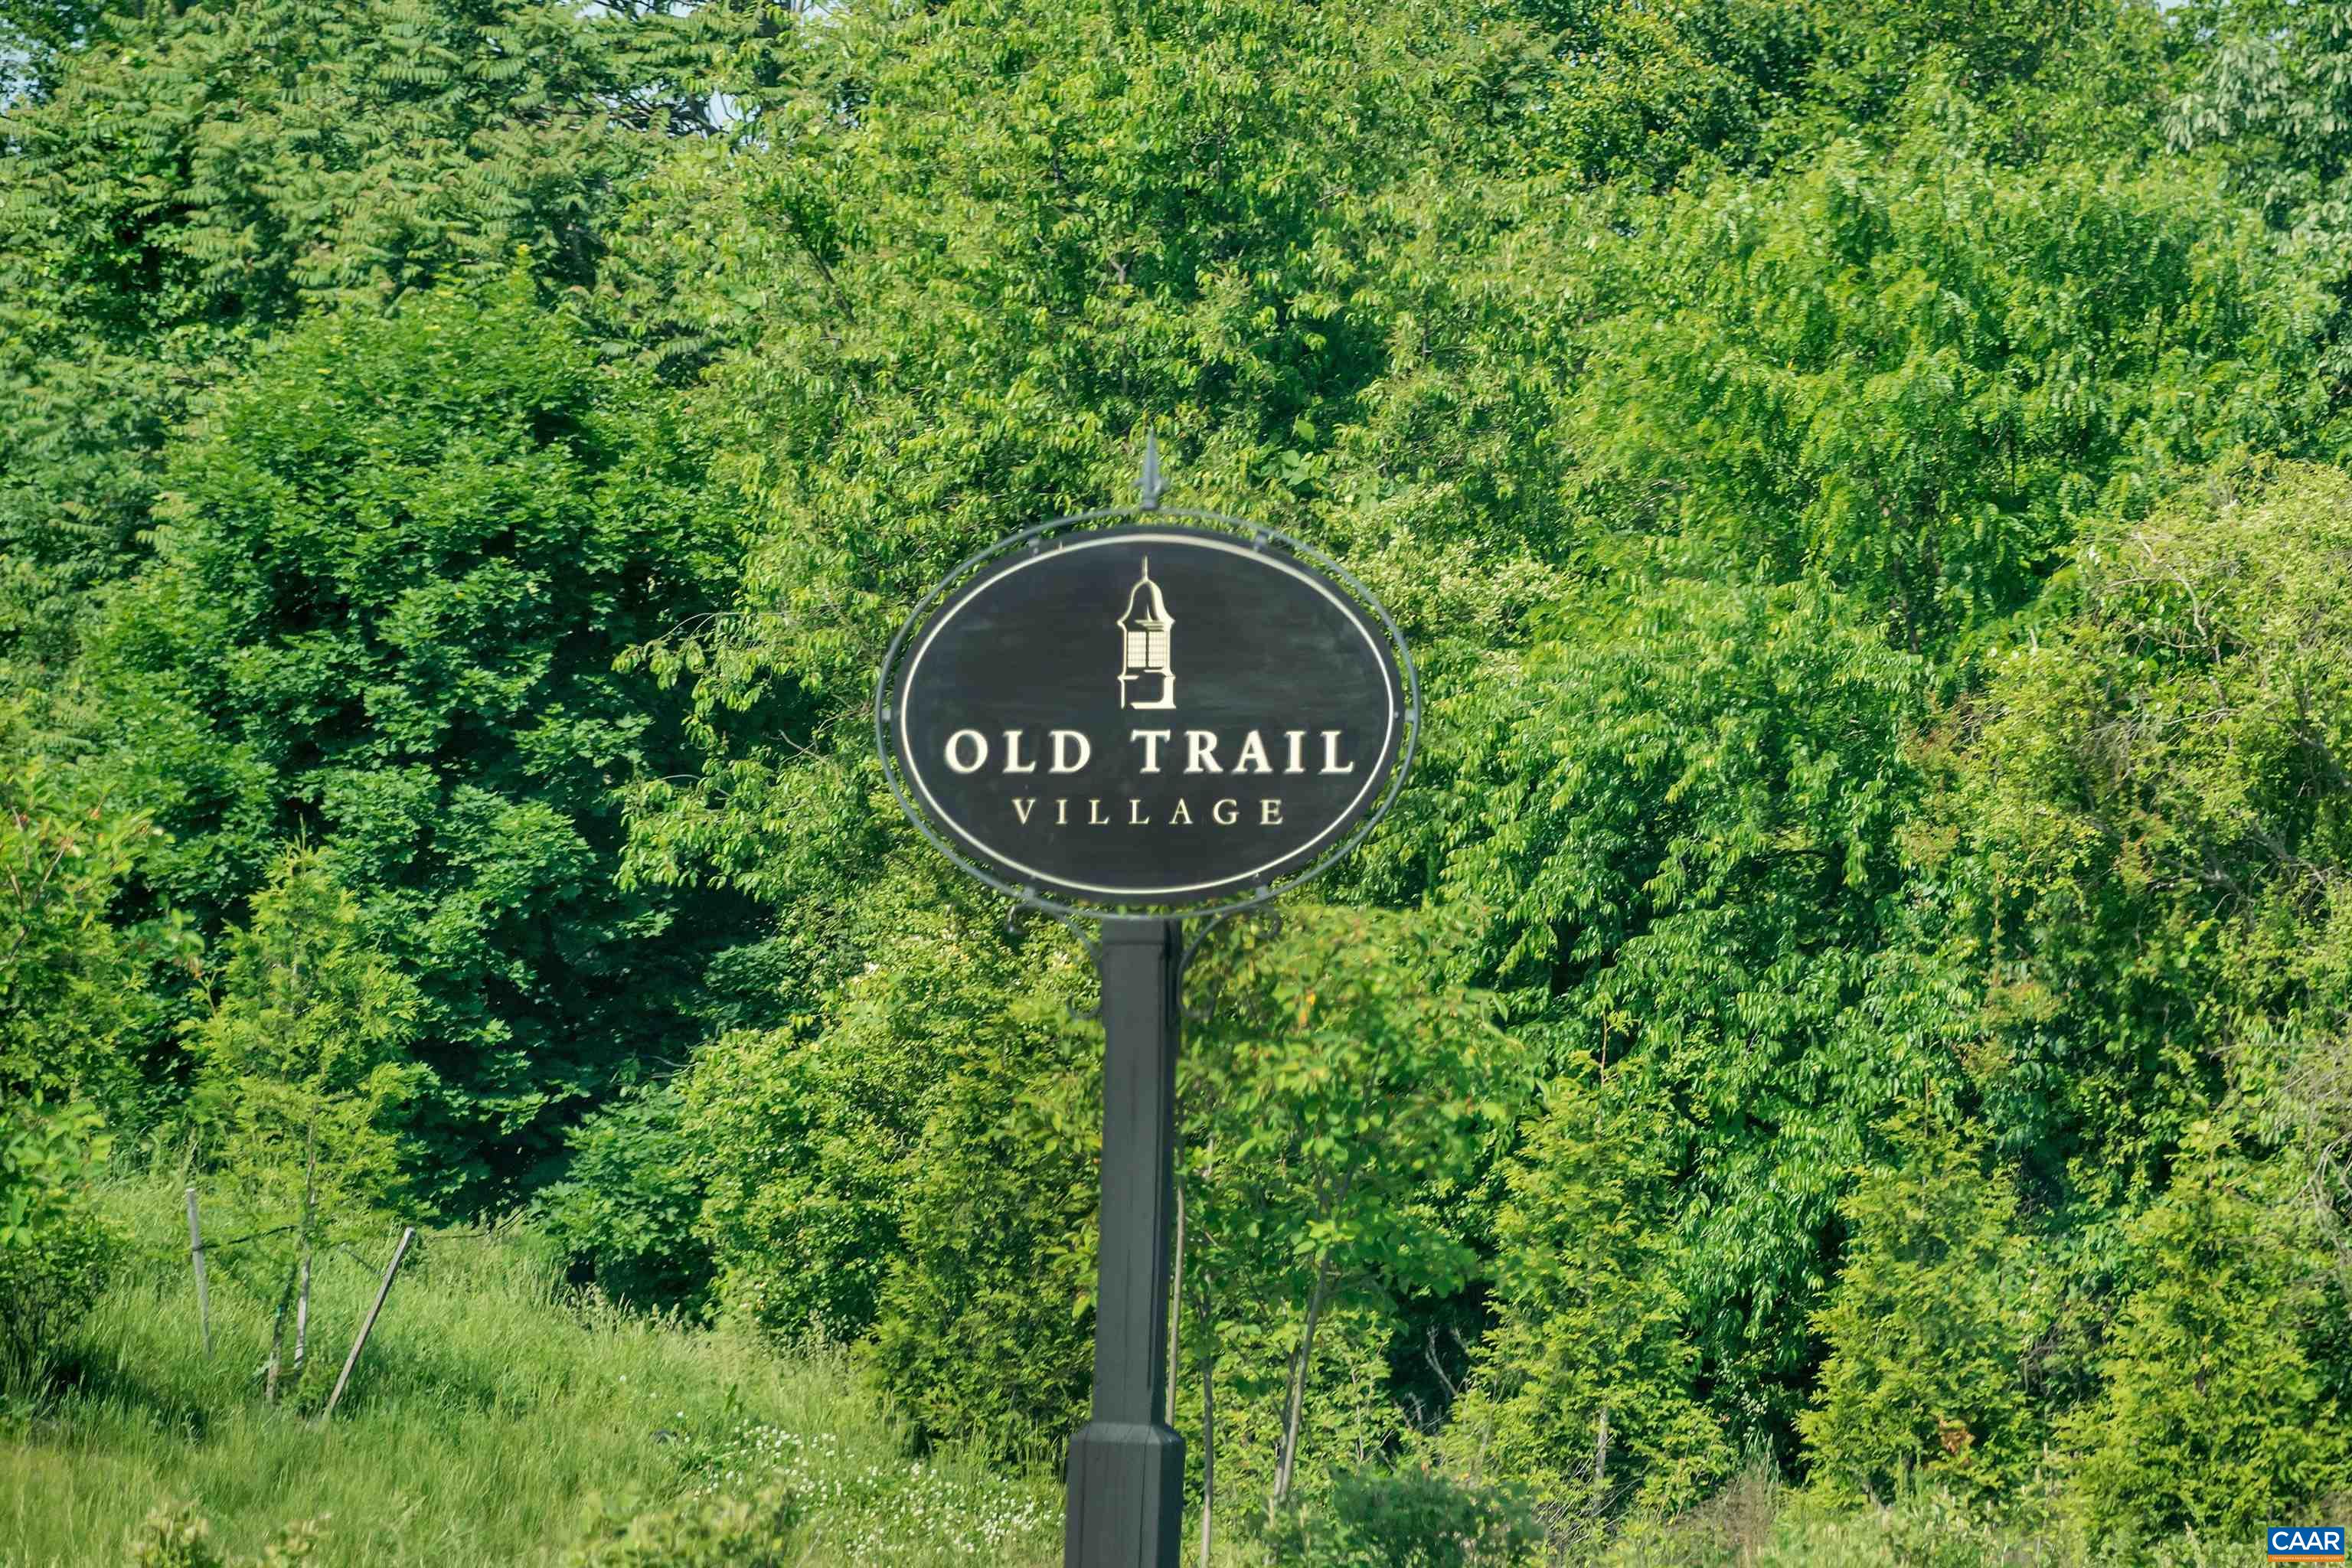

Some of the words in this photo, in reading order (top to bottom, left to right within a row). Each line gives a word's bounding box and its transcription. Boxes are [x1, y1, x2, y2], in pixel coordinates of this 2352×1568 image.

[944, 729, 1091, 774] OLD
[1130, 729, 1354, 775] TRAIL
[1011, 798, 1284, 825] VILLAGE
